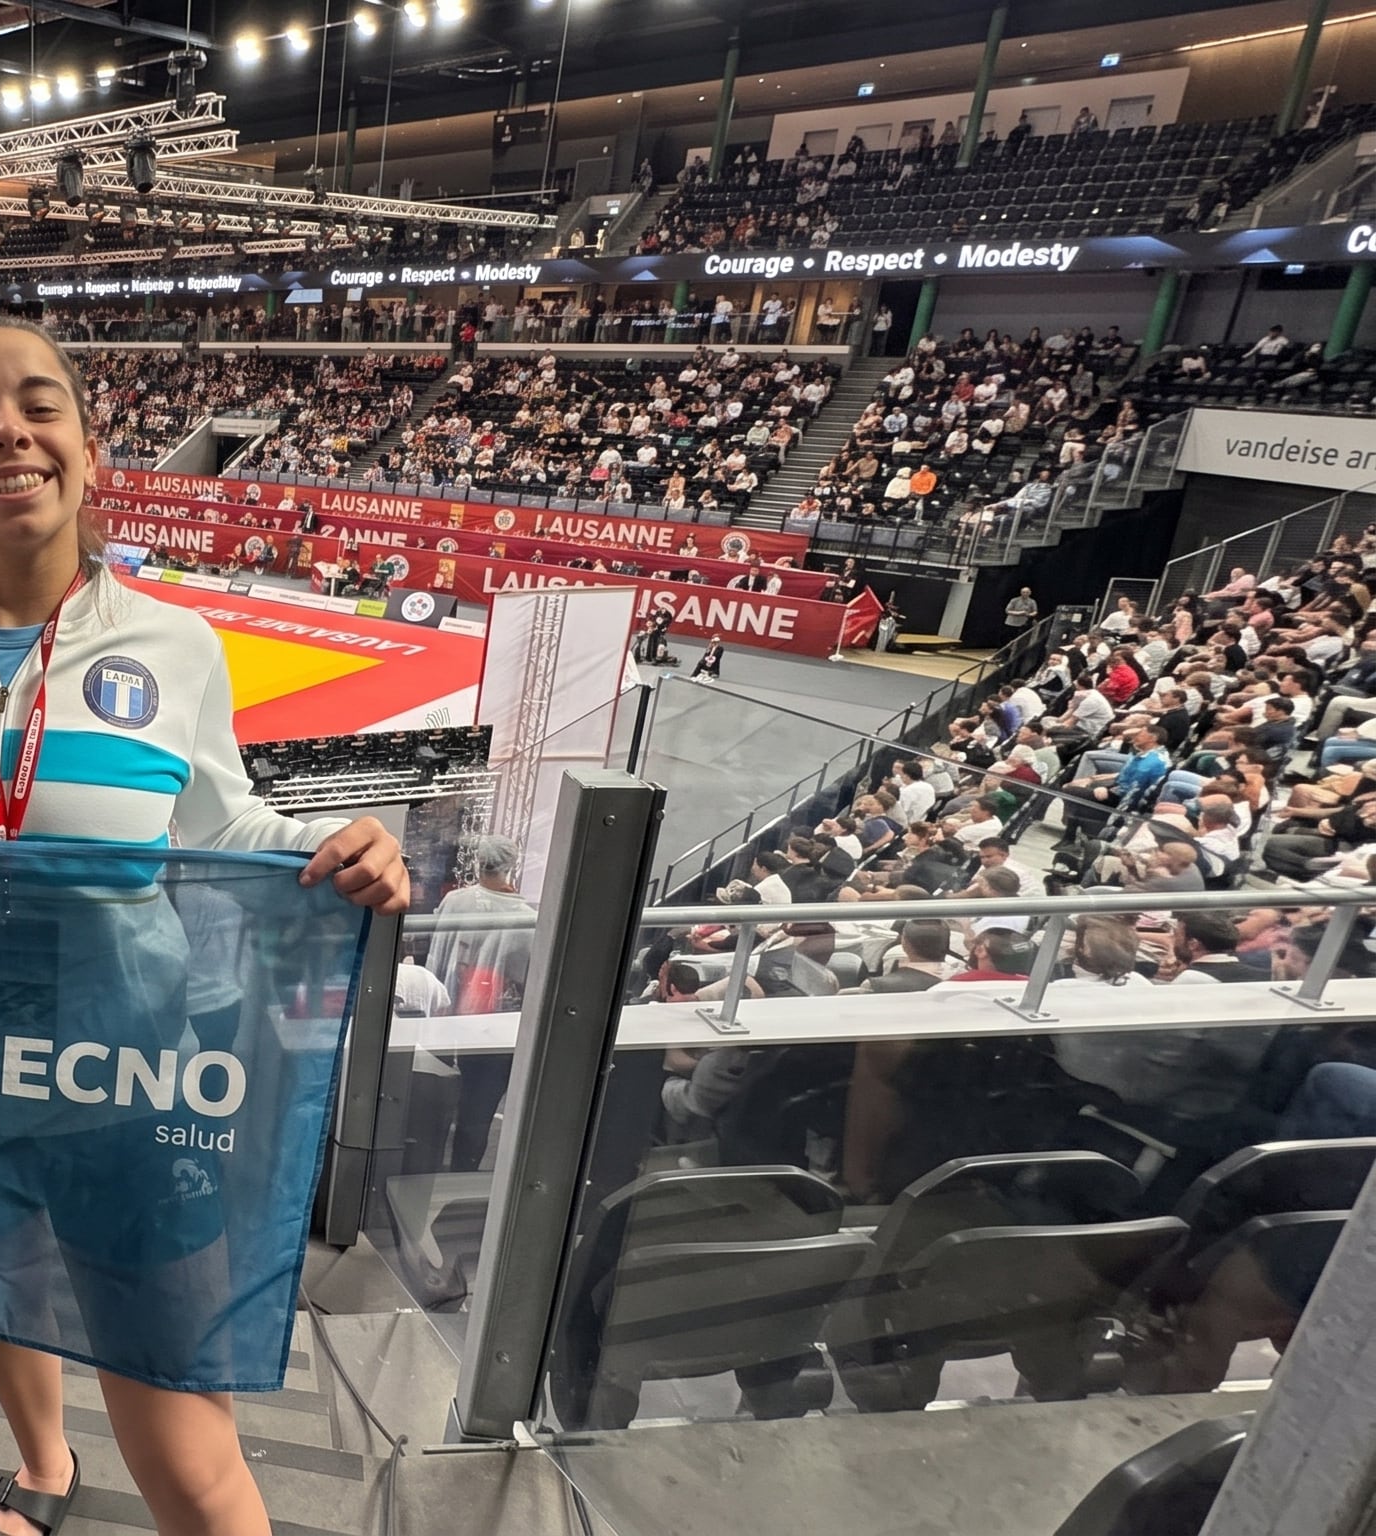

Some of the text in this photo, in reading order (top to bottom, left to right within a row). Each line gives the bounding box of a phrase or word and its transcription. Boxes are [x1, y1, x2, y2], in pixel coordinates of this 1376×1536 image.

[704, 241, 1080, 279] Courage Respect Modesty
[330, 262, 542, 290] Courage Respect Modesty
[1225, 437, 1376, 470] vandeise ar
[144, 474, 224, 497] LAUSANNE
[321, 492, 423, 520] LAUSANNE
[535, 513, 674, 548] LAUSANNE
[154, 1123, 236, 1152] salud
